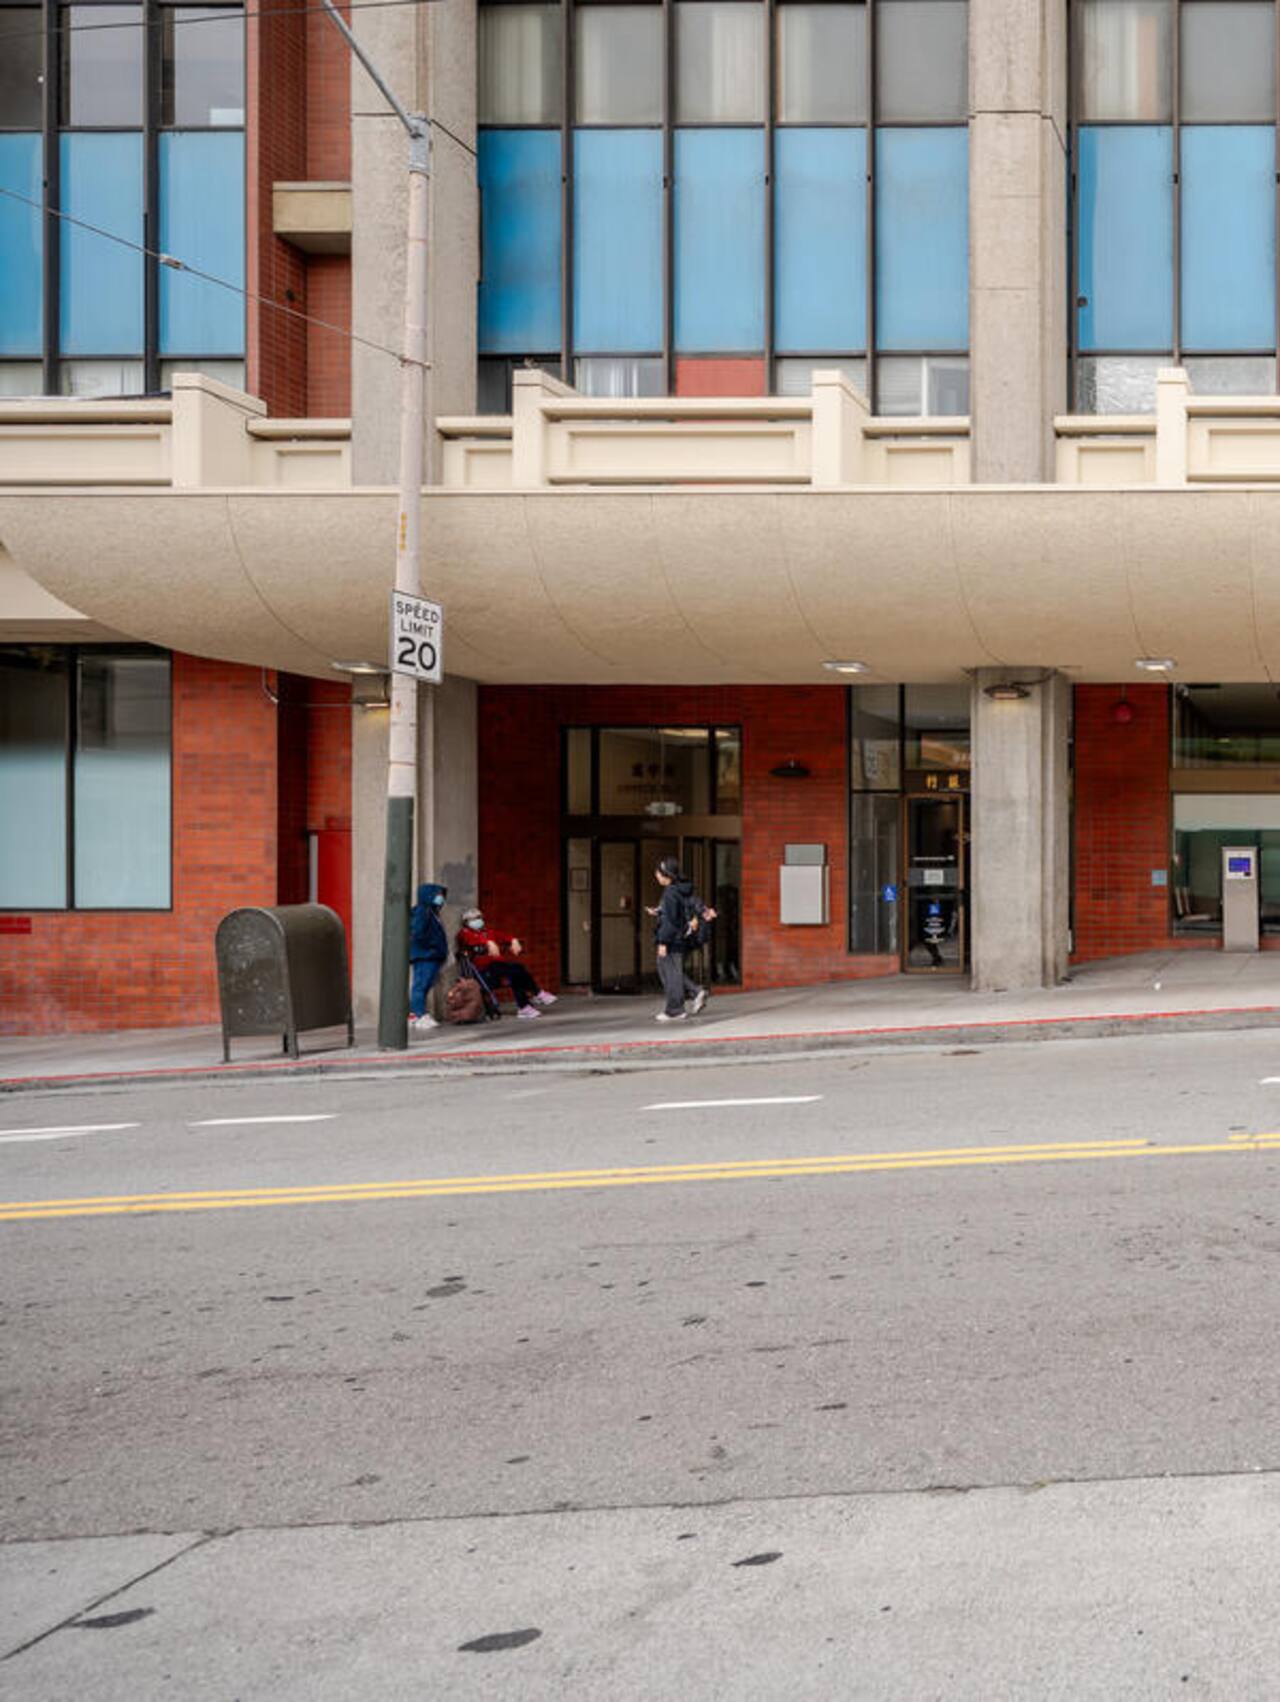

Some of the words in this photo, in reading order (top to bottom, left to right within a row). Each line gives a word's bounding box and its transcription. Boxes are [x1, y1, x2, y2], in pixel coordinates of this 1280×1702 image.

[396, 601, 440, 624] SPEED
[400, 618, 434, 638] LIMIT
[397, 636, 437, 671] 20
